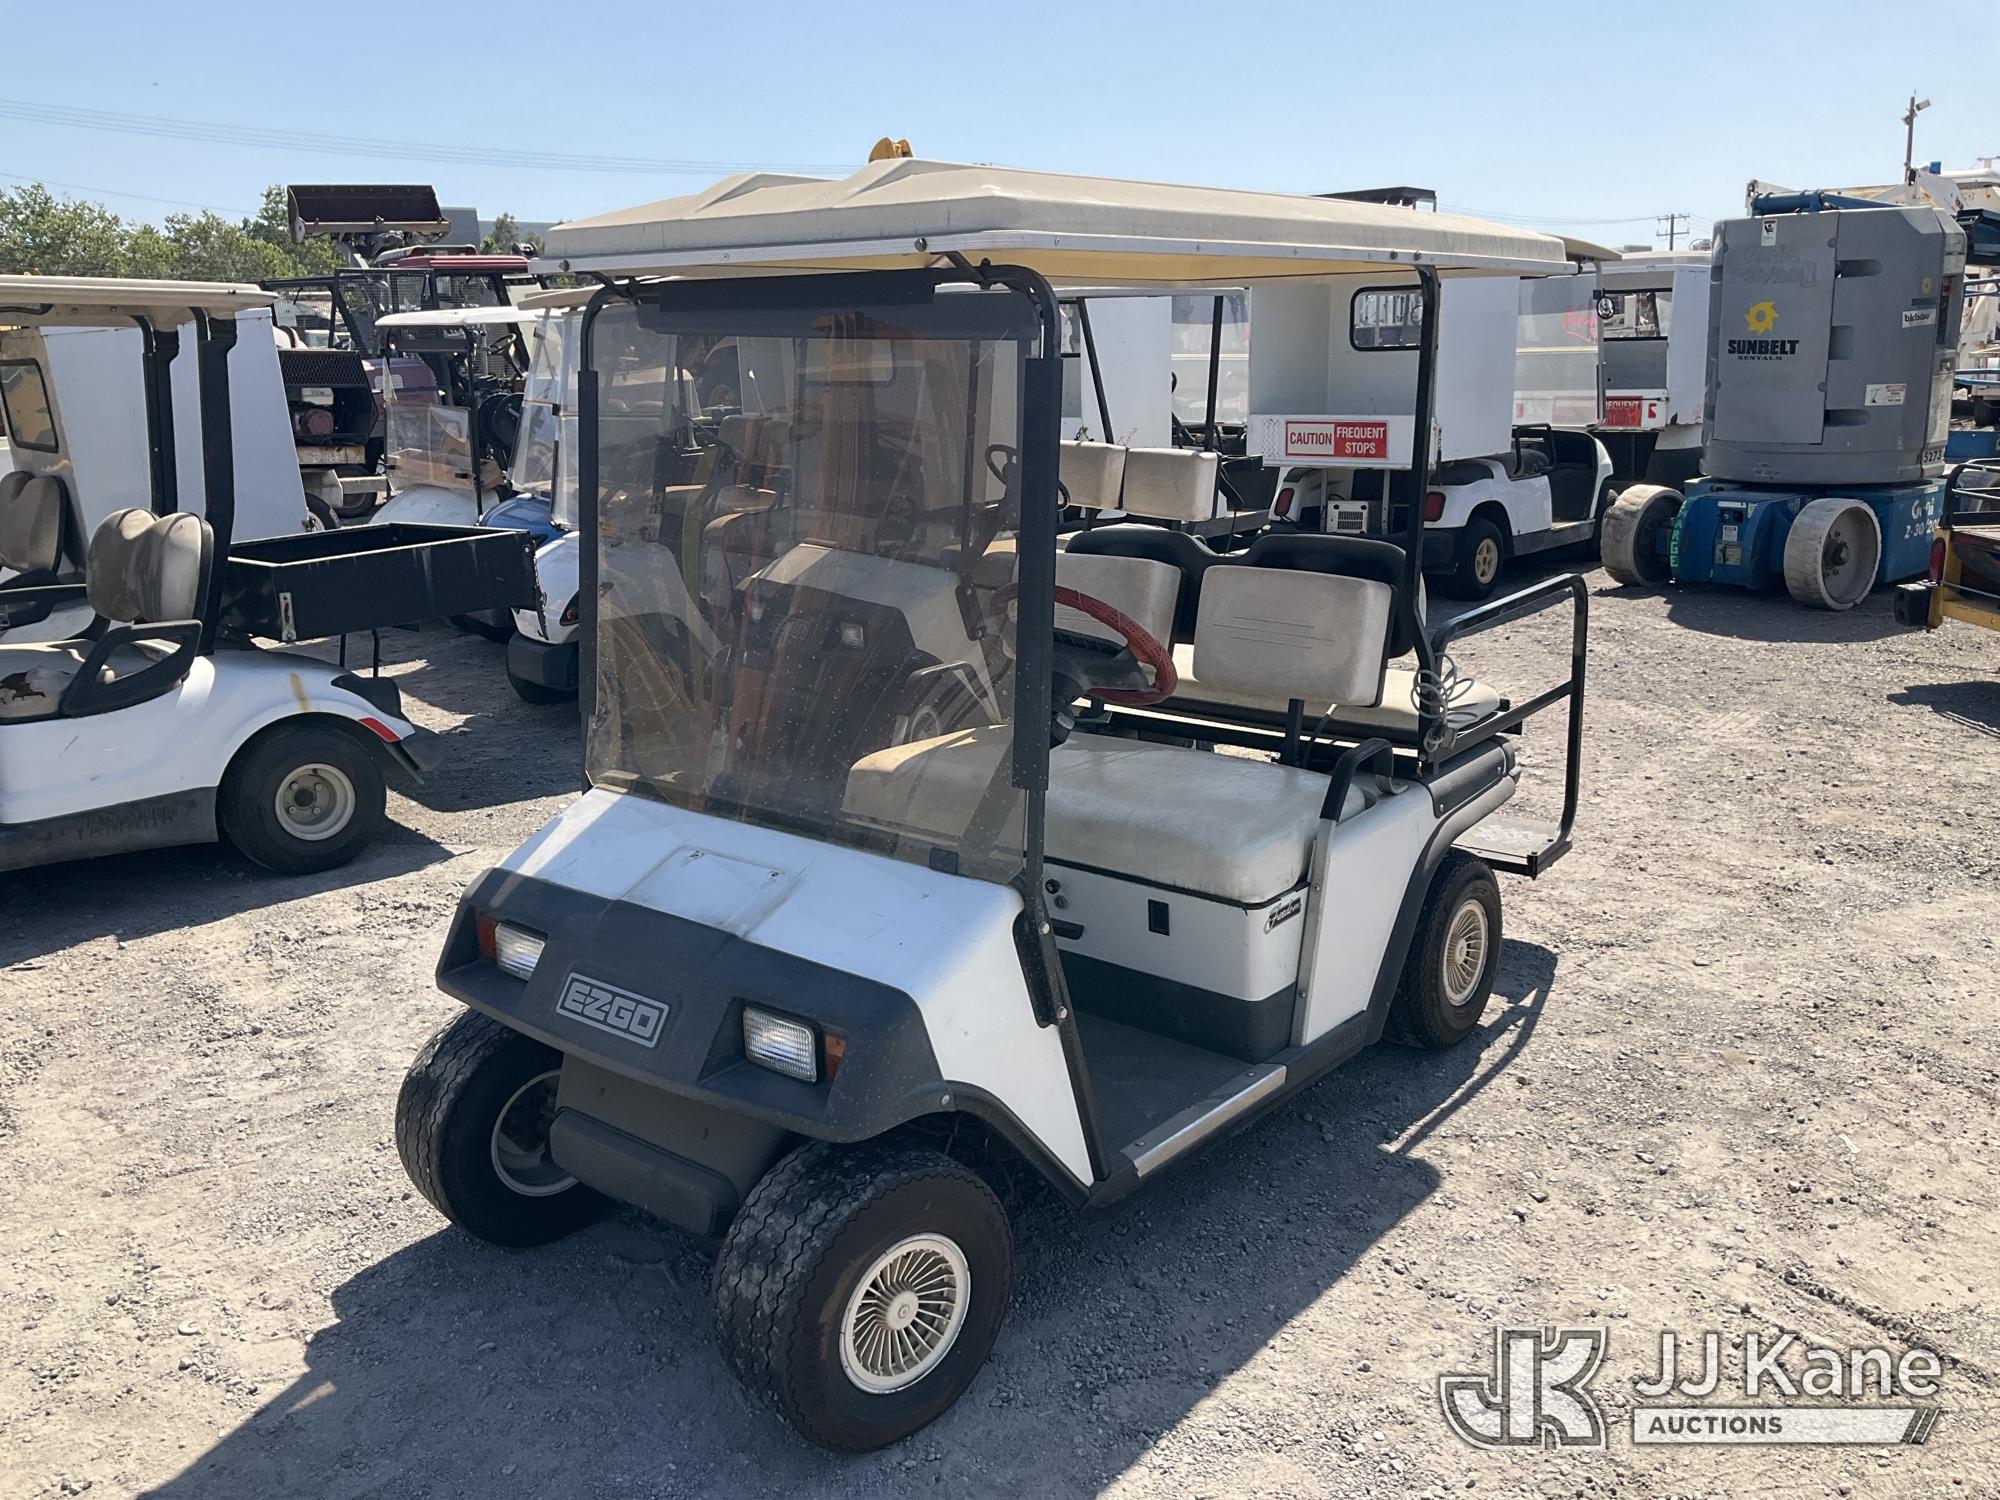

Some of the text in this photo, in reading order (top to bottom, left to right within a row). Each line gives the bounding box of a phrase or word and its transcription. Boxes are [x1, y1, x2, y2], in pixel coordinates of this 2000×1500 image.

[1727, 339, 1800, 355] SUNBELT
[1606, 400, 1640, 410] EQUENT
[1289, 426, 1386, 445] CAUTION FREQUENT
[1345, 442, 1376, 455] STOPS
[564, 981, 660, 1038] EZGO
